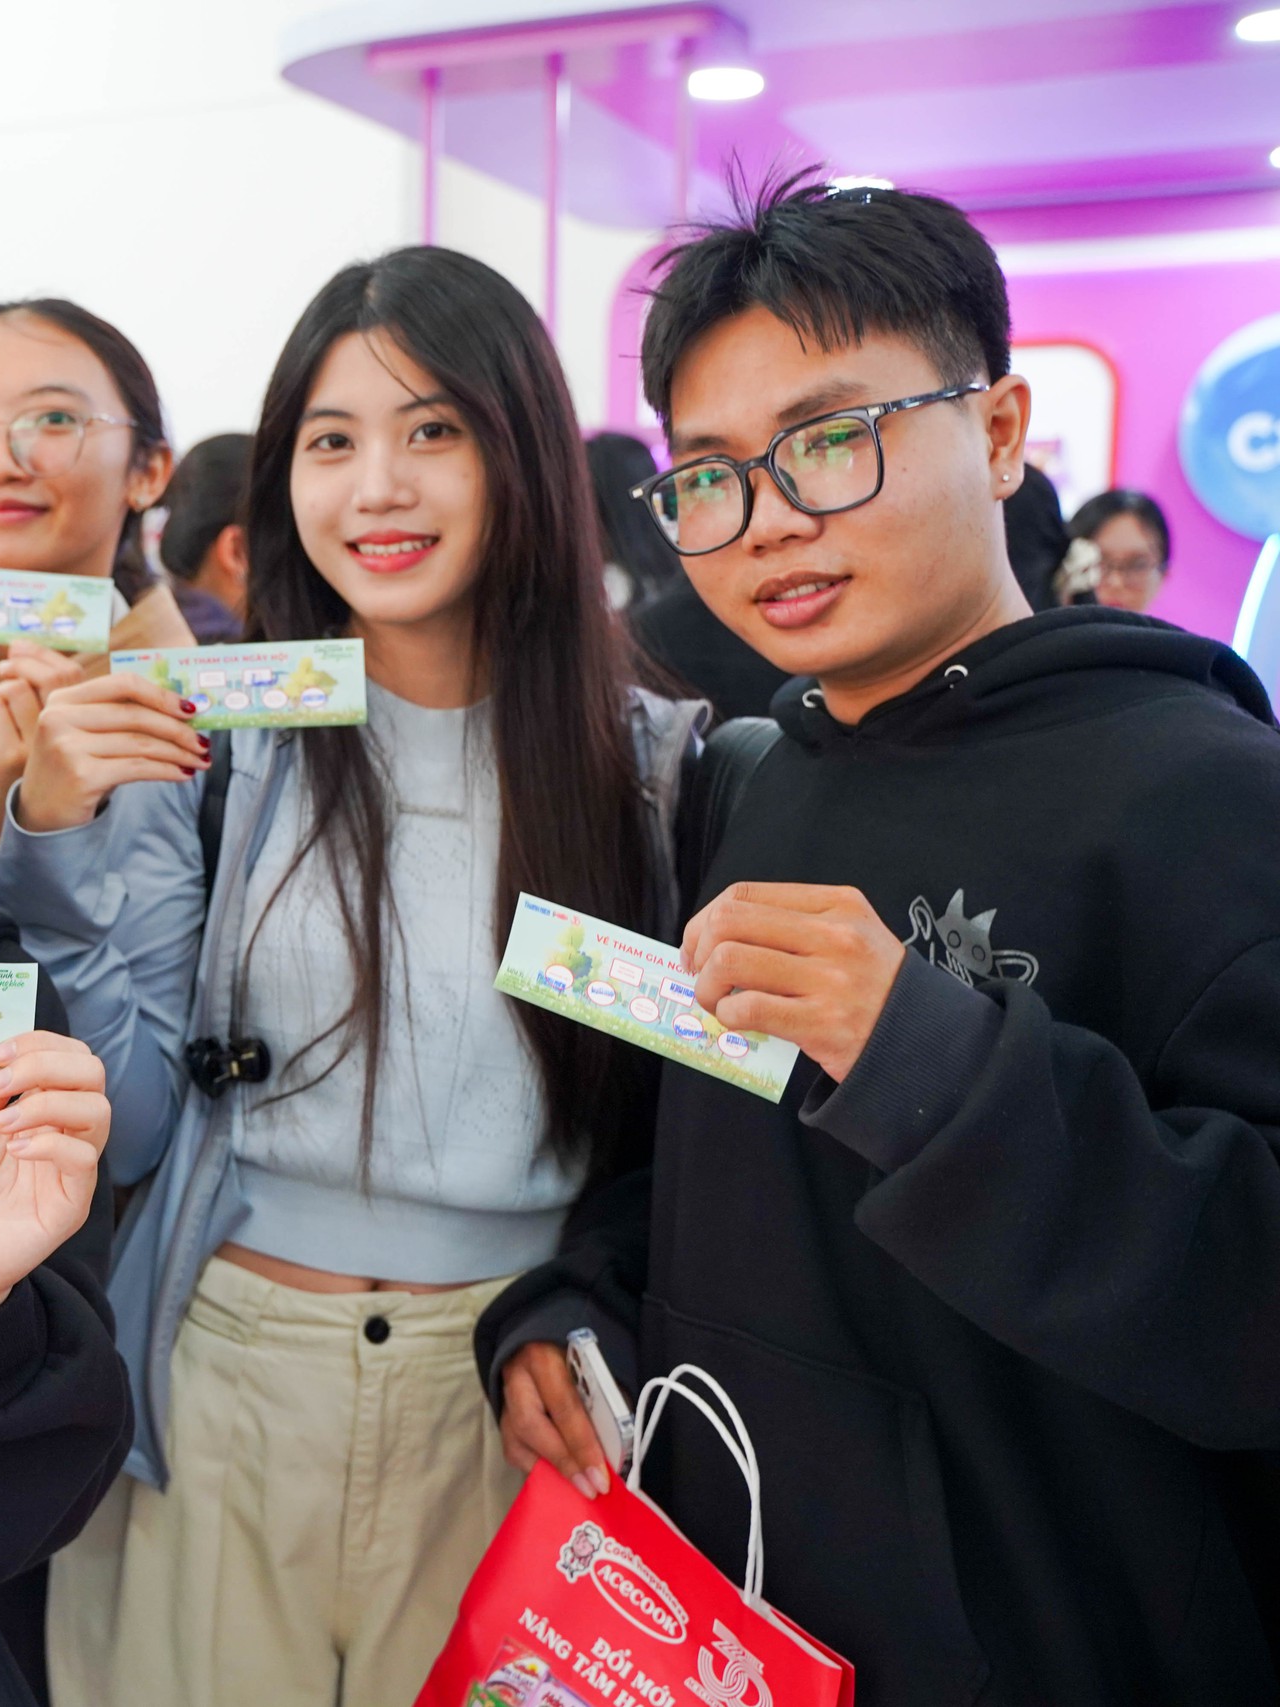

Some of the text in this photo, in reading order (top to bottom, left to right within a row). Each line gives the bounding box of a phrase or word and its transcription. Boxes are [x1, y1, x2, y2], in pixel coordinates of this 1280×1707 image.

[613, 940, 643, 958] THAM
[645, 953, 664, 966] GIA
[604, 1540, 633, 1562] Cook
[518, 1606, 573, 1660] NÂNG
[590, 1637, 635, 1680] ĐỔI
